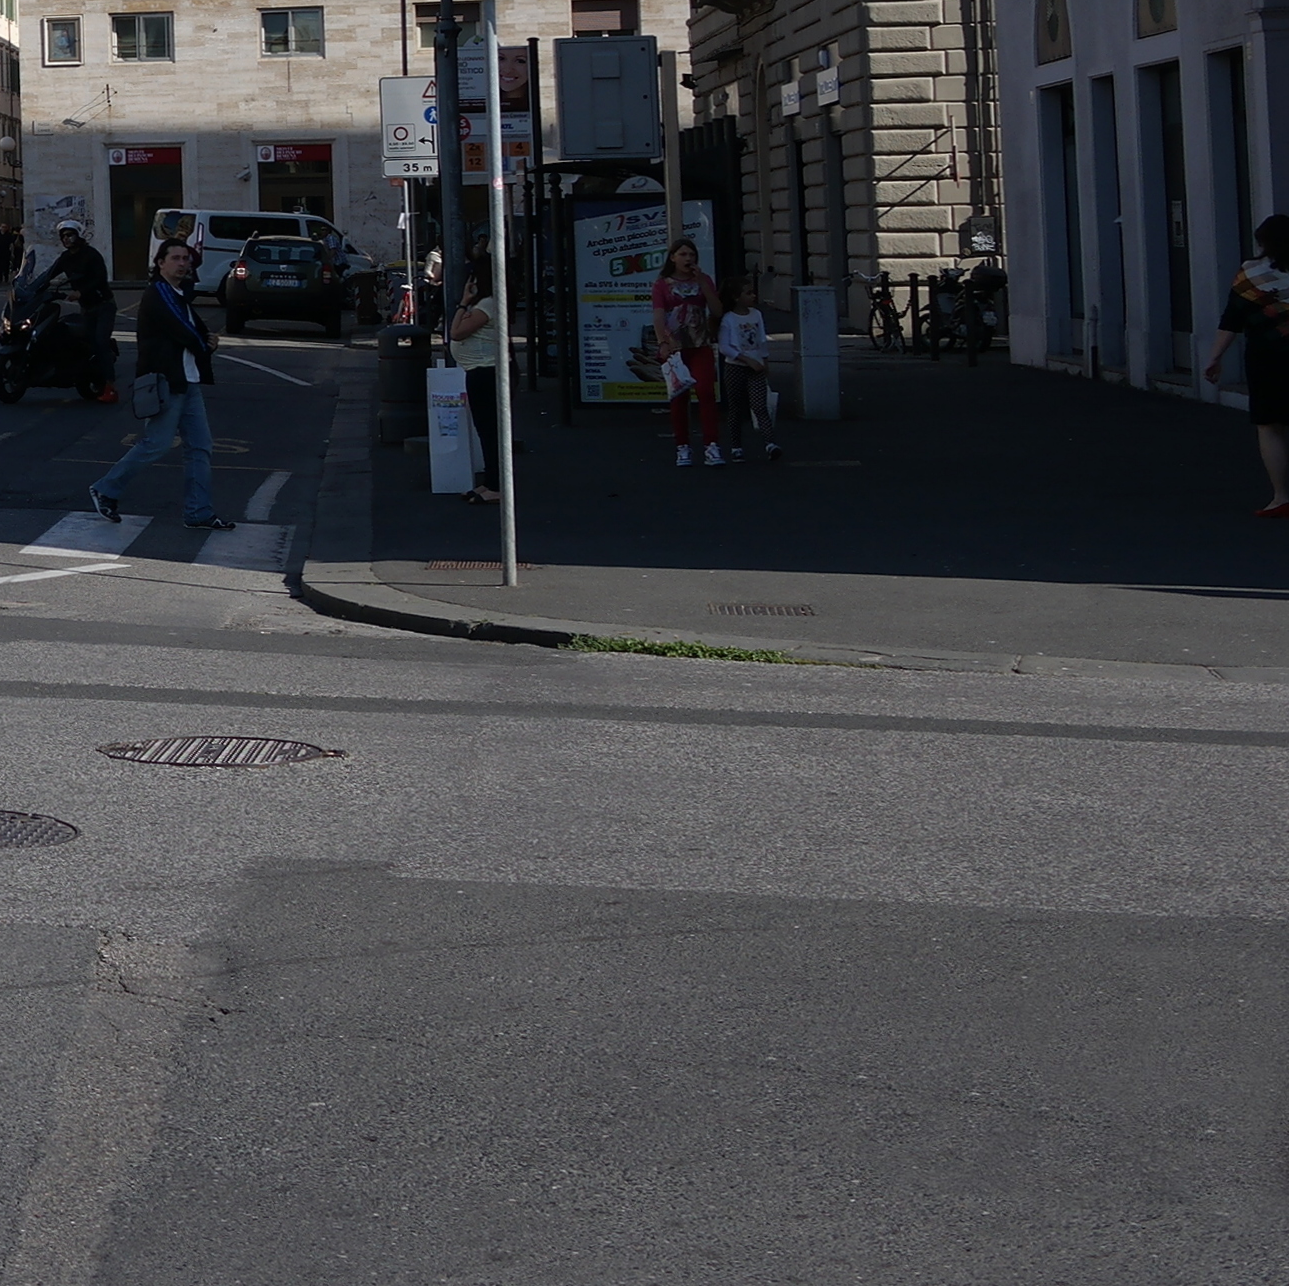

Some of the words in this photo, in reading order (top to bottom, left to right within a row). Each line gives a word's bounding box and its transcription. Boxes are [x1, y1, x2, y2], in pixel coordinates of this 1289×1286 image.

[403, 163, 419, 172] 35
[586, 237, 614, 248] Anche
[614, 235, 626, 243] un
[626, 228, 657, 242] piccolo
